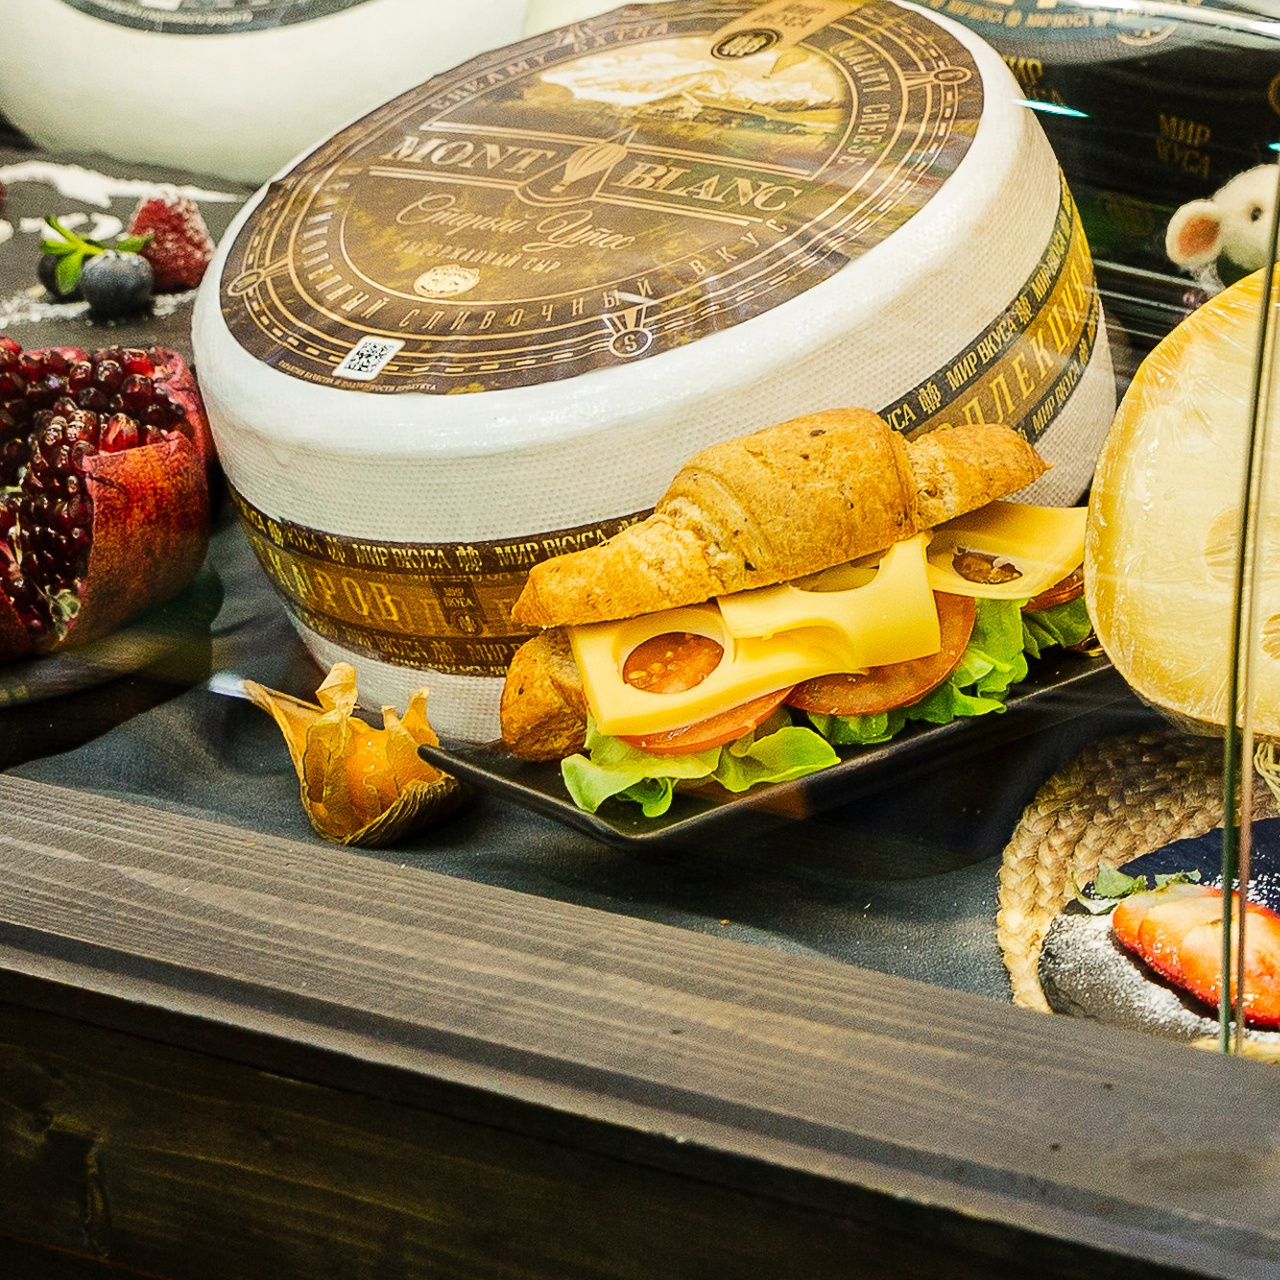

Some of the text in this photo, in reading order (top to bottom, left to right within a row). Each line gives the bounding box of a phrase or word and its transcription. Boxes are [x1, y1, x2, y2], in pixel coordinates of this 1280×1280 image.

[829, 39, 891, 166] QUALITY CHEESE
[381, 135, 804, 214] MONT BLANC
[393, 240, 563, 274] ВЫДЕРЖАННЫЙ СЫР
[398, 277, 655, 331] СЛИВОЧНЫЙ
[688, 218, 788, 279] ВКУС
[946, 352, 979, 392] МИР
[976, 317, 1018, 366] ВКУСА
[1030, 262, 1052, 302] МИР
[1031, 397, 1056, 435] МИР
[351, 543, 389, 567] МИР
[391, 547, 452, 571] ВКУСА
[494, 541, 540, 567] МИР
